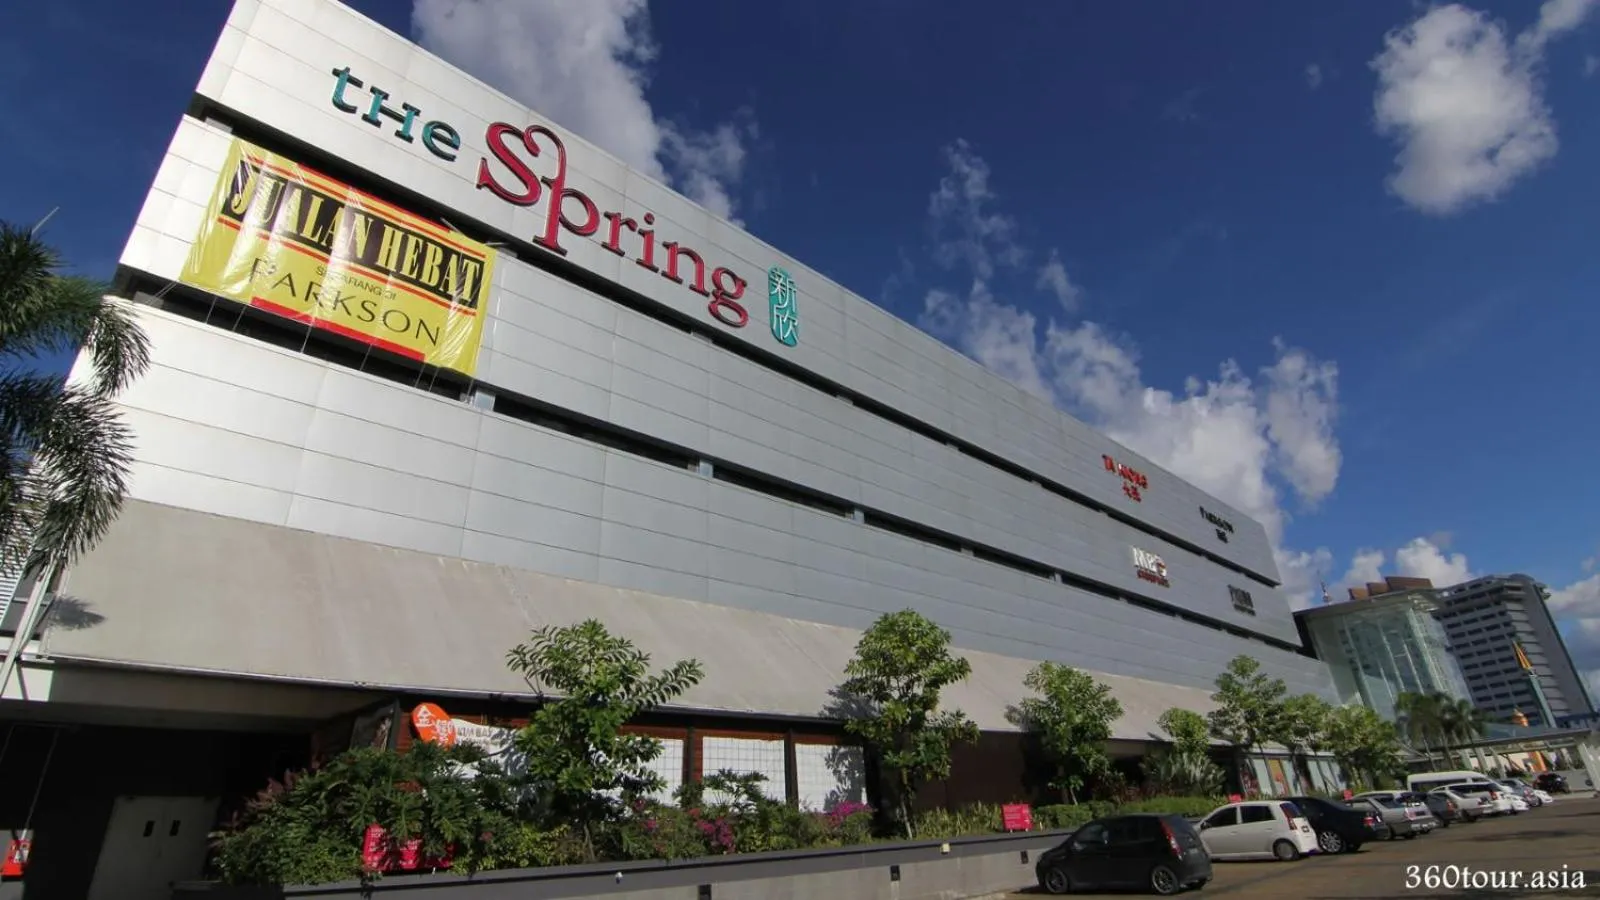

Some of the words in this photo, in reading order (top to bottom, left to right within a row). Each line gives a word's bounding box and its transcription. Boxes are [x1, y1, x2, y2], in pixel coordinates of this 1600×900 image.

[229, 162, 374, 259] JUALAN
[375, 224, 480, 303] HEBAT
[476, 122, 749, 328] Spring
[250, 257, 440, 346] PARKSON
[316, 264, 383, 297] SARANG
[768, 266, 799, 345] 新欣
